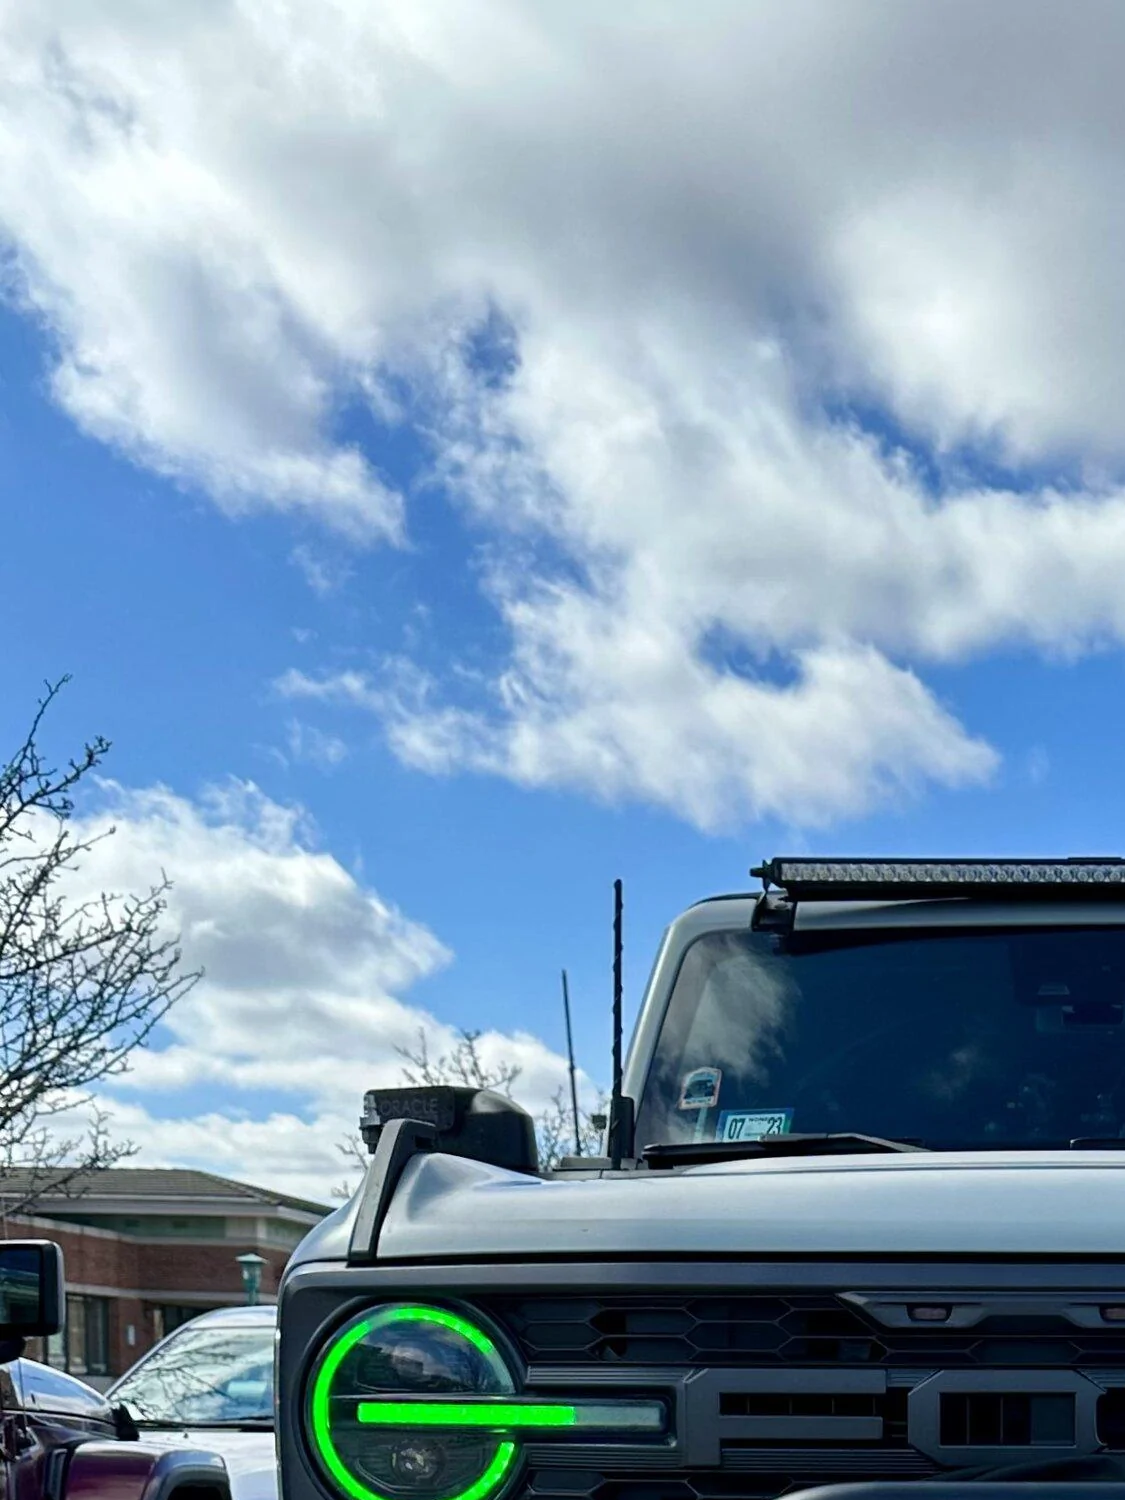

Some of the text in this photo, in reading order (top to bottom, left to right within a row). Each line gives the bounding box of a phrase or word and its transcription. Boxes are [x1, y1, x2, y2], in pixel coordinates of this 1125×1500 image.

[380, 1098, 439, 1115] ORACLE
[729, 1118, 746, 1139] 07
[767, 1117, 783, 1135] 23
